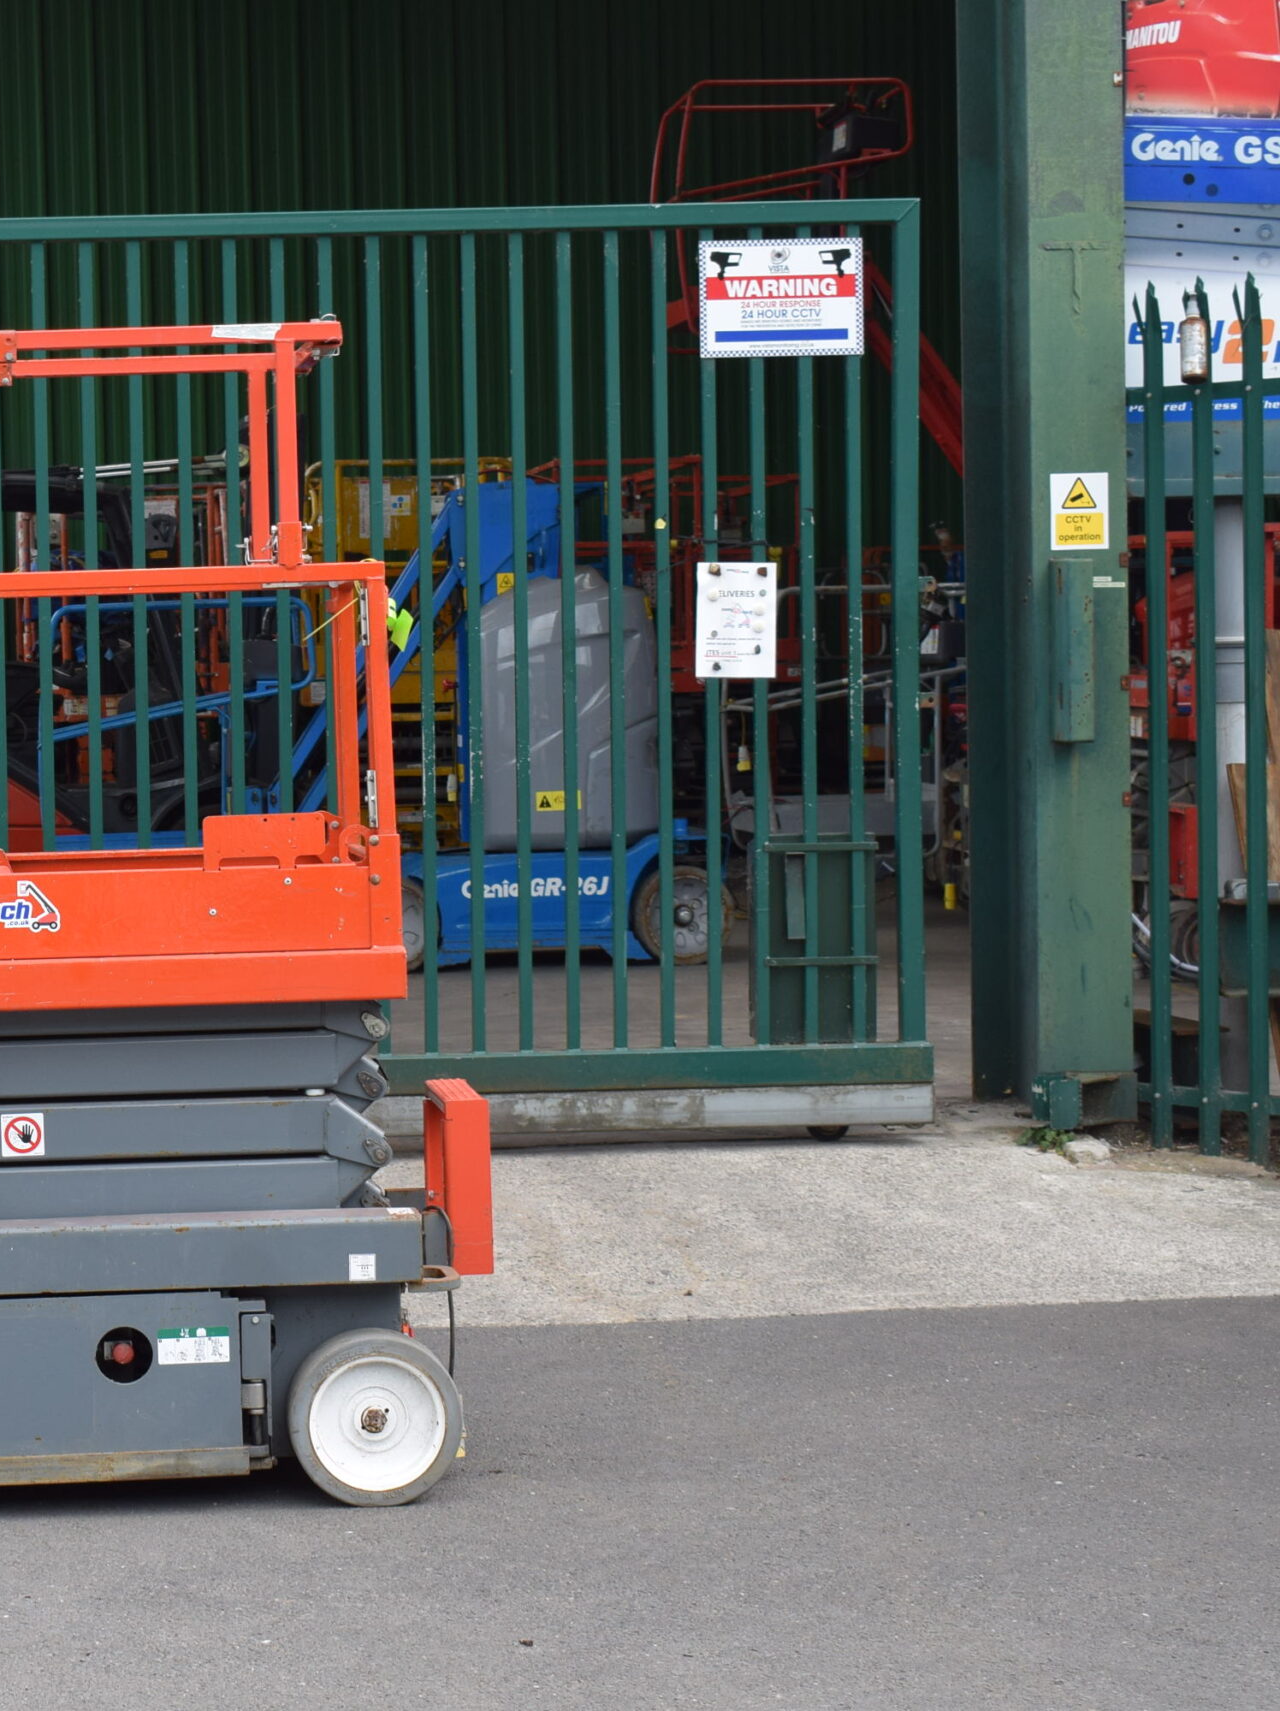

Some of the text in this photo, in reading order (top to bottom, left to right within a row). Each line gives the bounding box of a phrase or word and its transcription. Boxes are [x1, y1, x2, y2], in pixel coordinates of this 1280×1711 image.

[1131, 132, 1223, 162] Genie
[724, 277, 838, 298] WARNING
[740, 299, 822, 309] 24 HOUR RESPONSE
[741, 308, 822, 319] 24 HOUR CCTV
[1065, 515, 1092, 524] CCTV
[1058, 533, 1102, 543] operation
[718, 590, 756, 598] ELIVERIES
